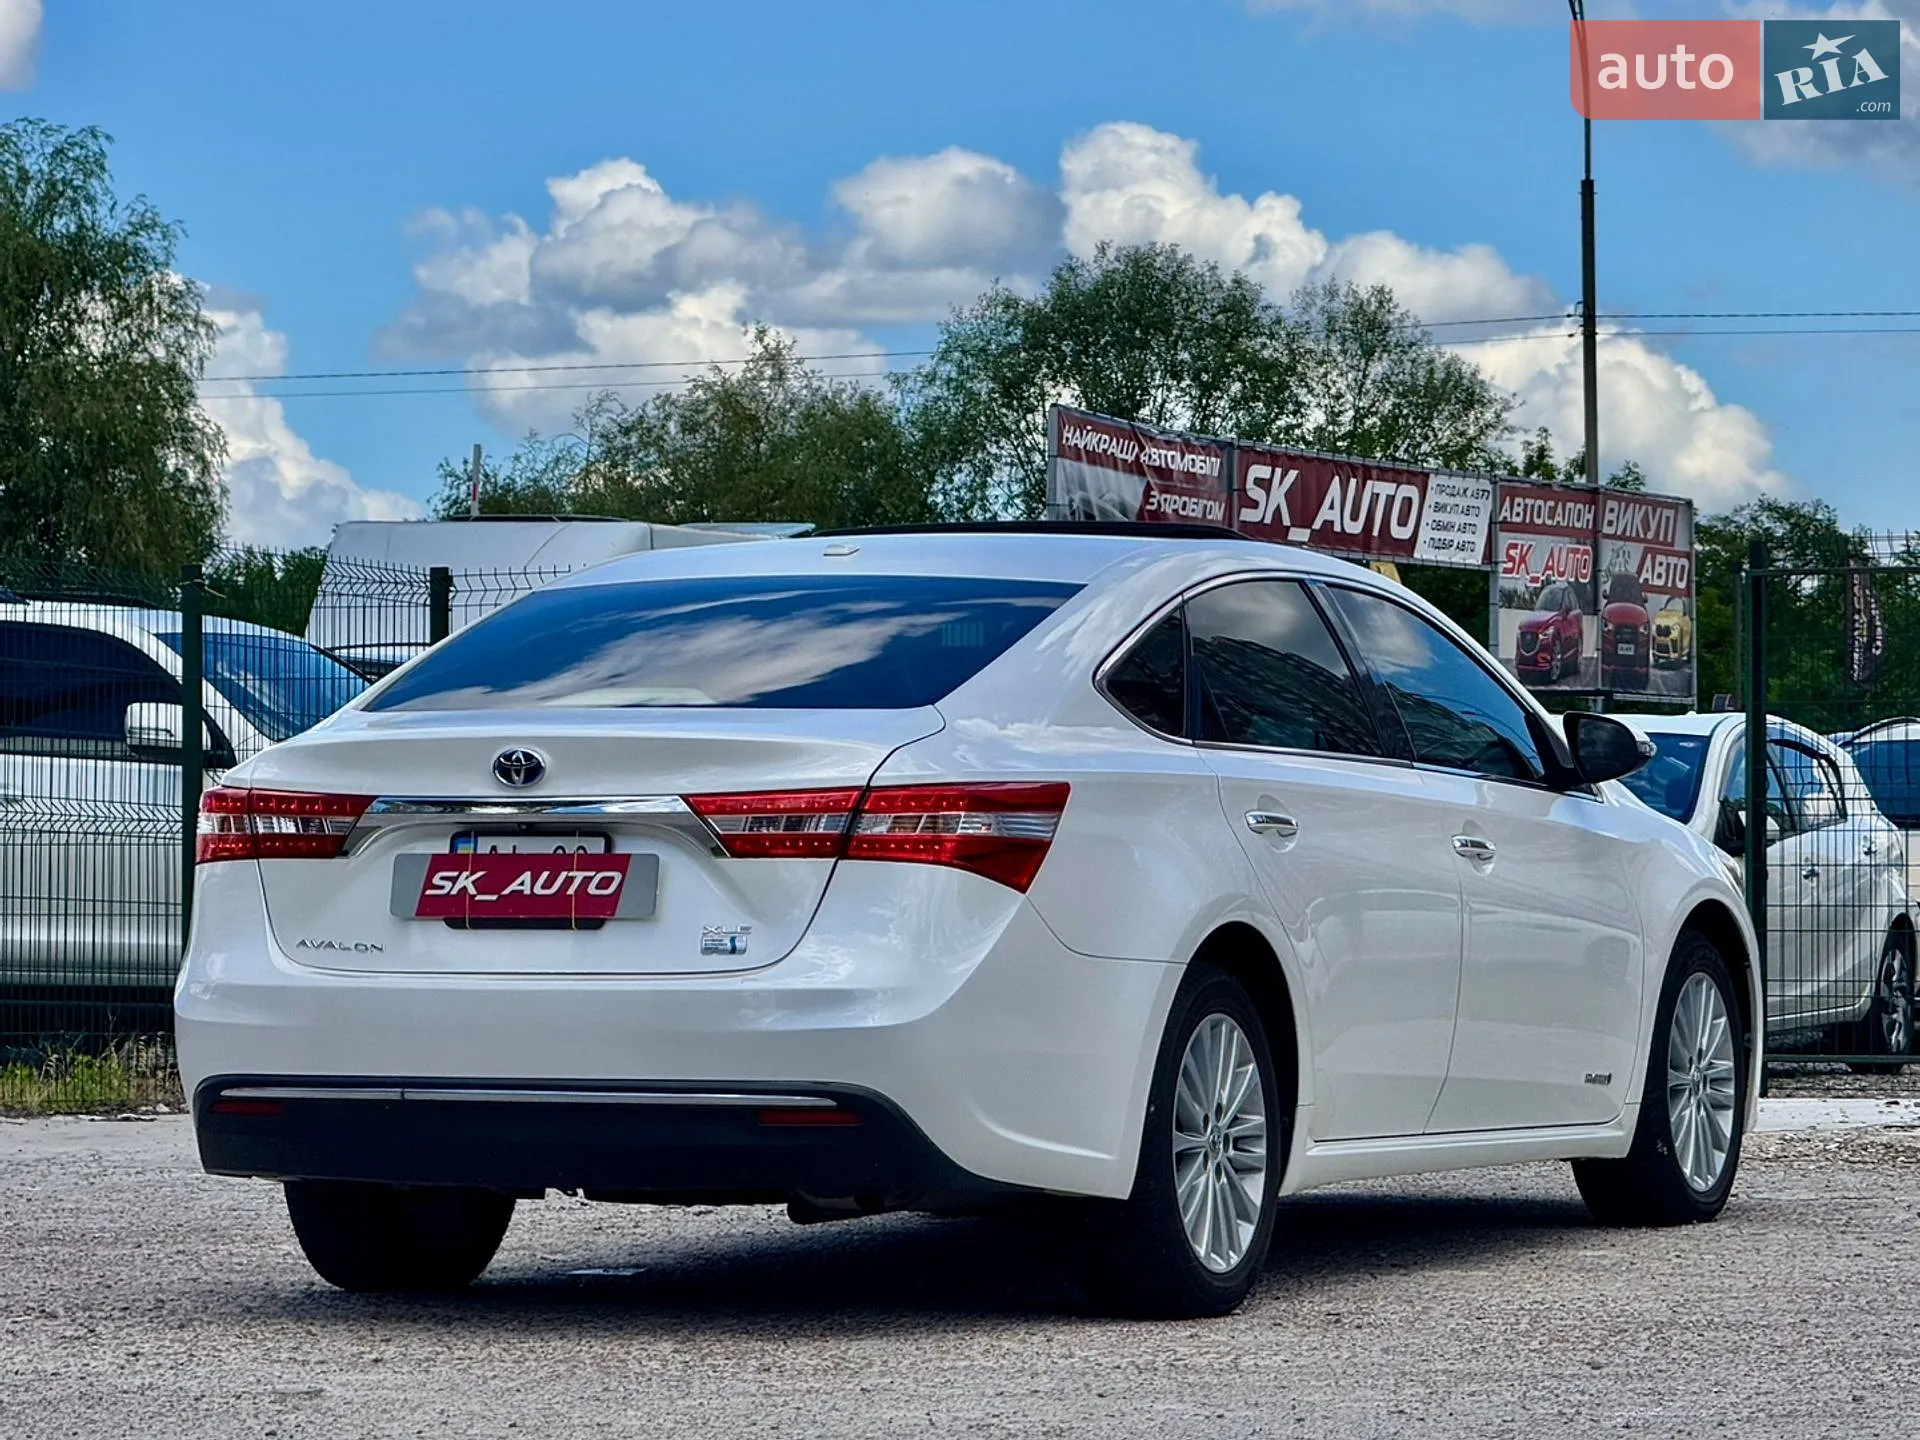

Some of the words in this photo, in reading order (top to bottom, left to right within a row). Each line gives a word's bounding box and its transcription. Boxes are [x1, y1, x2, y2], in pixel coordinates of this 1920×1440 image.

[1062, 424, 1138, 463] НАЙКРАЩІ
[1239, 464, 1420, 543] SK_AUTO
[1433, 501, 1460, 515] ВИКУП
[1461, 505, 1480, 518] АВТО
[1499, 496, 1595, 529] АВТОСАЛОН
[1456, 522, 1477, 535] АВТО
[1602, 500, 1675, 543] ВИКУП
[1455, 540, 1476, 553] АВТО
[1500, 540, 1593, 587] SK_AUTO
[1639, 553, 1690, 589] АВТО
[424, 871, 622, 901] SK_AUTO
[296, 939, 384, 953] AVALON
